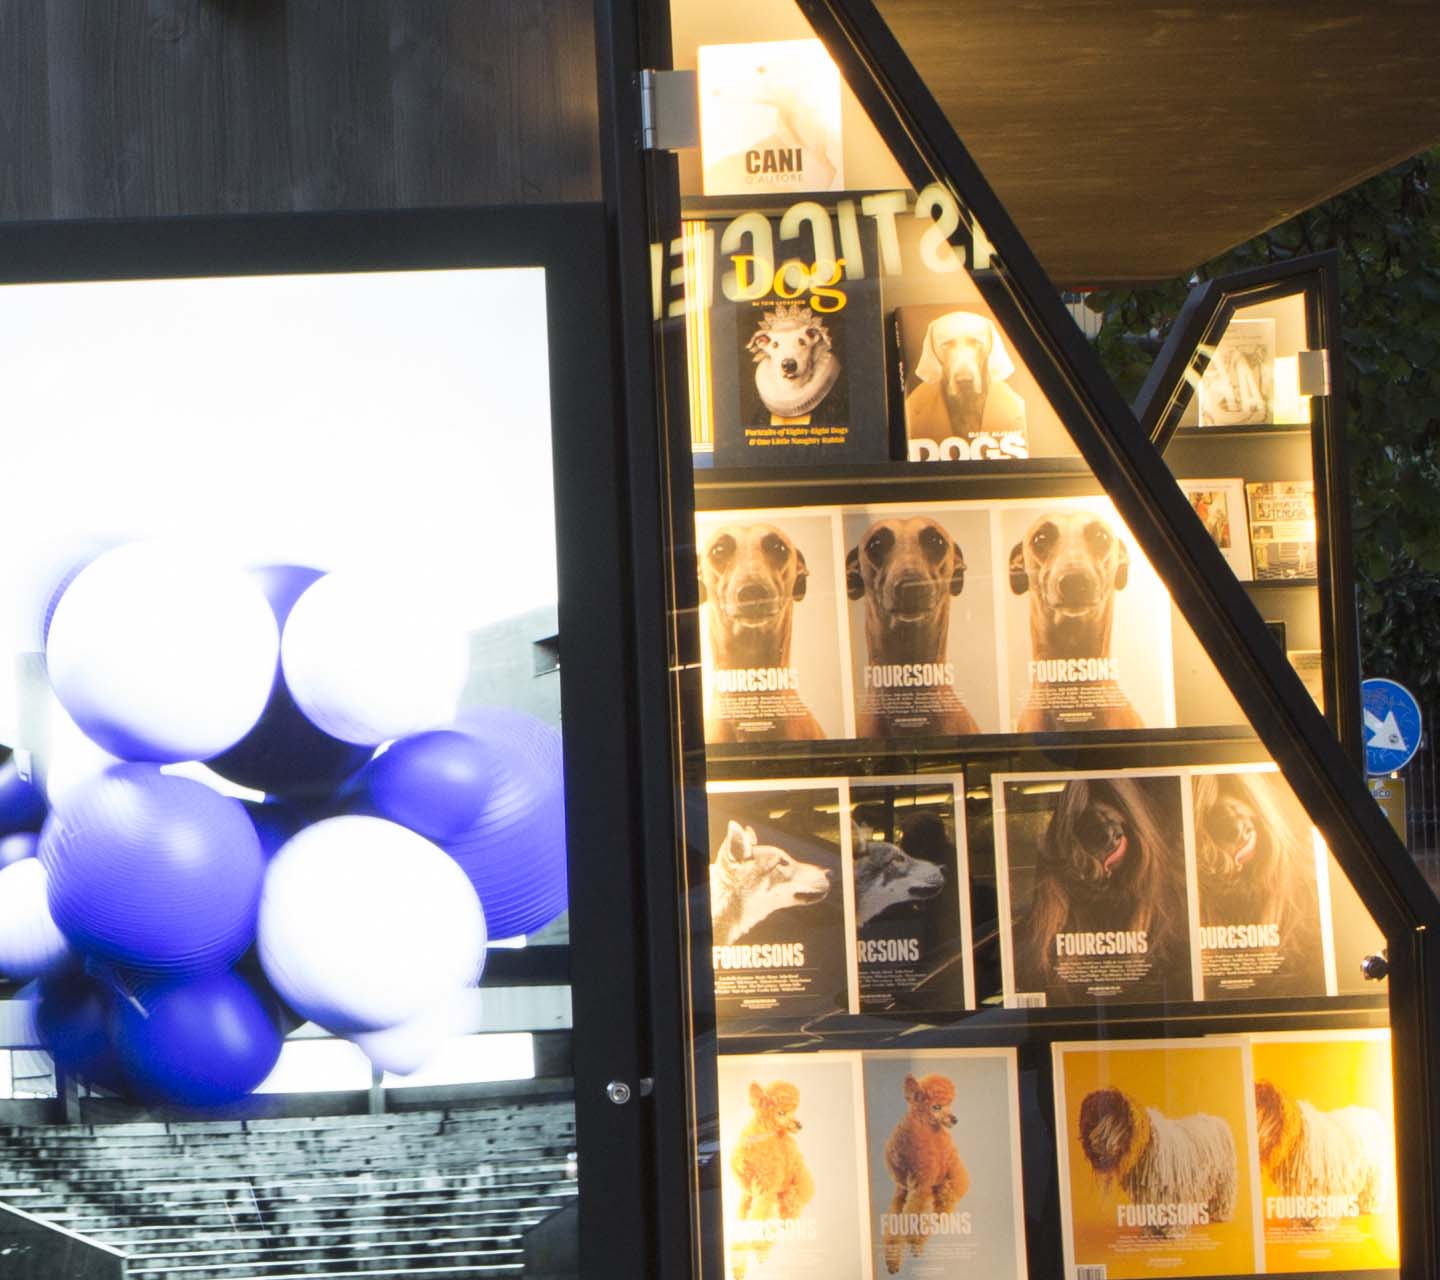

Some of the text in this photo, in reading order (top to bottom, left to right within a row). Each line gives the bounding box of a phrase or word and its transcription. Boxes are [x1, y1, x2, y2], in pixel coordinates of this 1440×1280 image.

[745, 147, 804, 175] CANI
[731, 254, 847, 313] Dog
[908, 433, 1028, 461] DOGS
[1200, 923, 1281, 949] OUR&SONS
